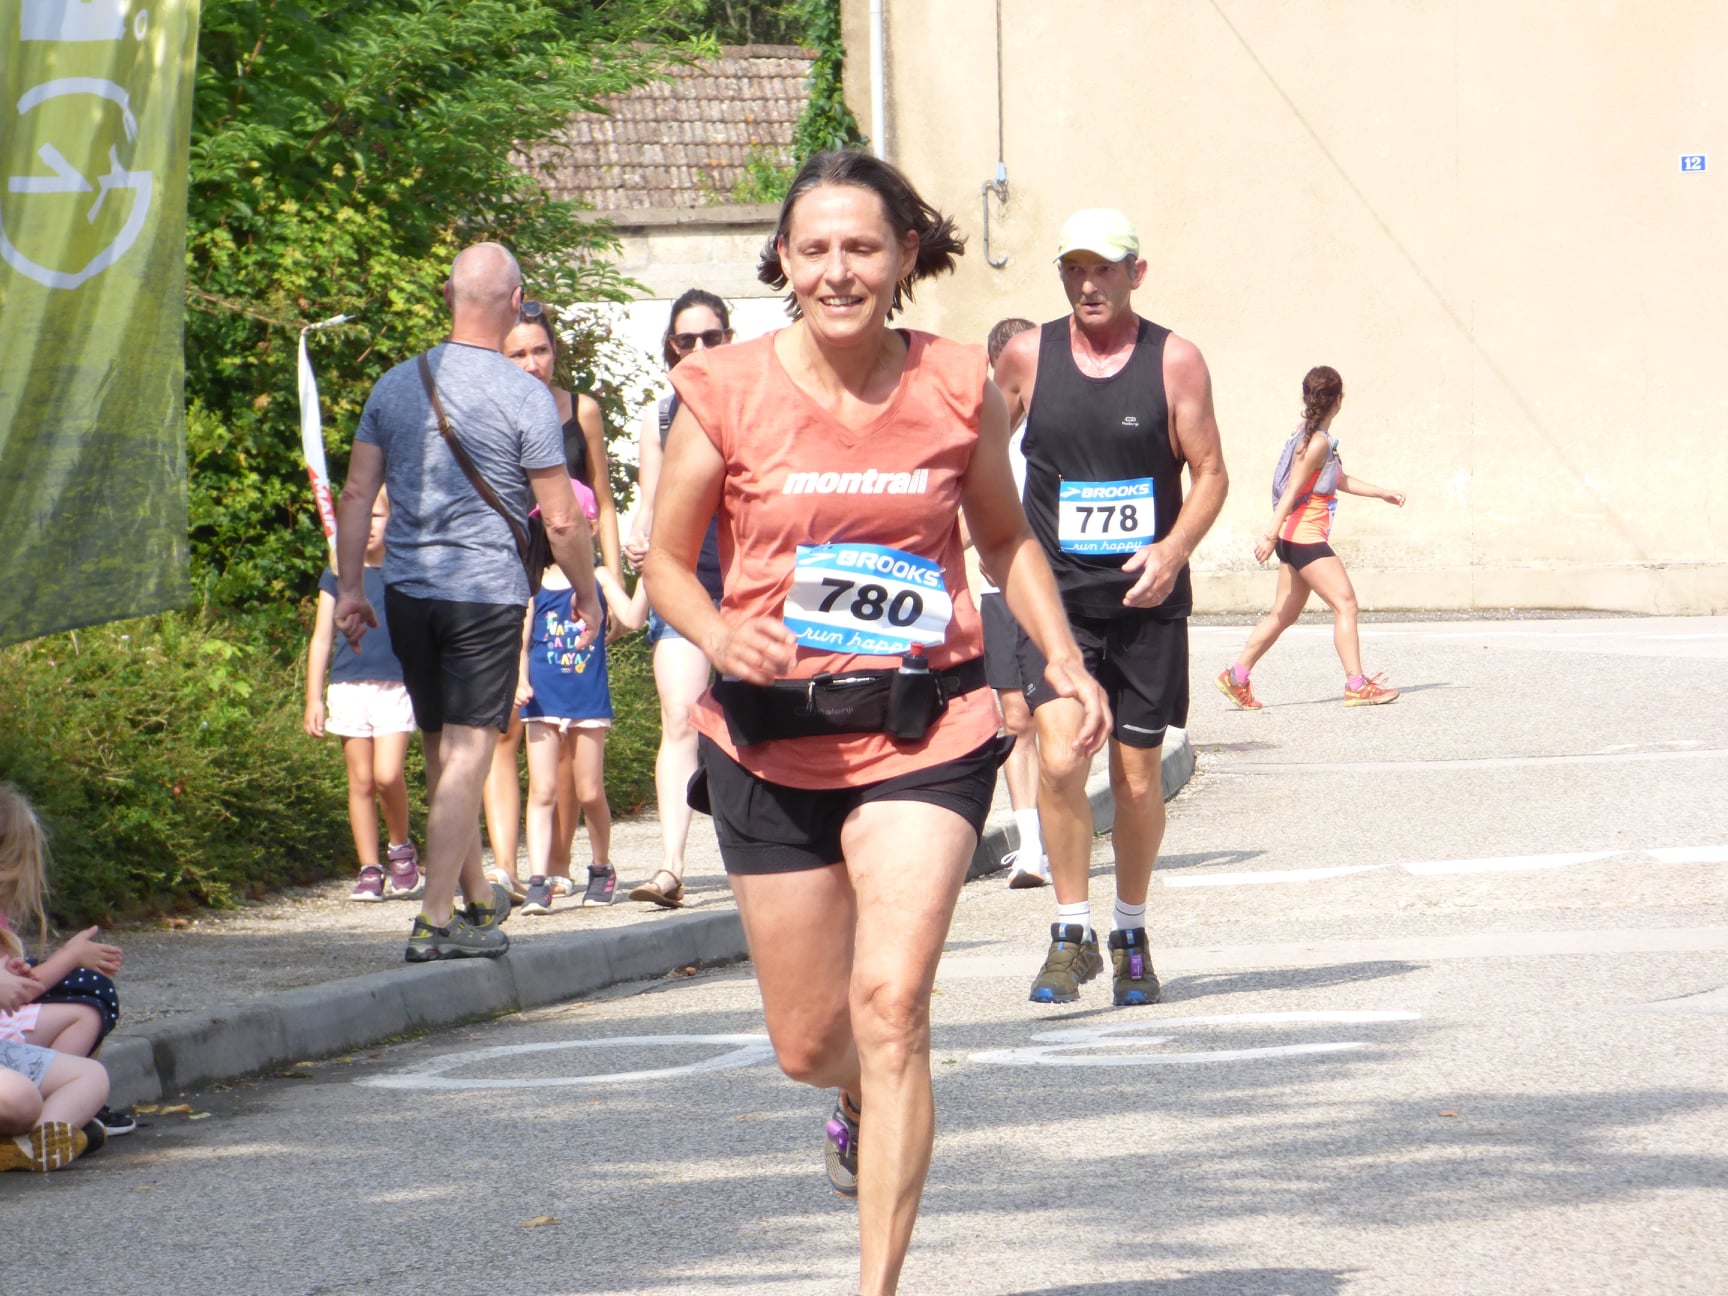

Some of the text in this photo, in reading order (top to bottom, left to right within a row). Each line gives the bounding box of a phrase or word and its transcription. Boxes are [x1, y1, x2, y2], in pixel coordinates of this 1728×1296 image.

[1684, 156, 1702, 170] 12
[782, 468, 929, 494] montrail
[1081, 483, 1150, 499] BROOKS
[1076, 504, 1138, 534] 778
[1066, 542, 1098, 551] run
[836, 550, 941, 587] BROOKS
[818, 577, 924, 627] 780
[797, 626, 912, 654] run happ
